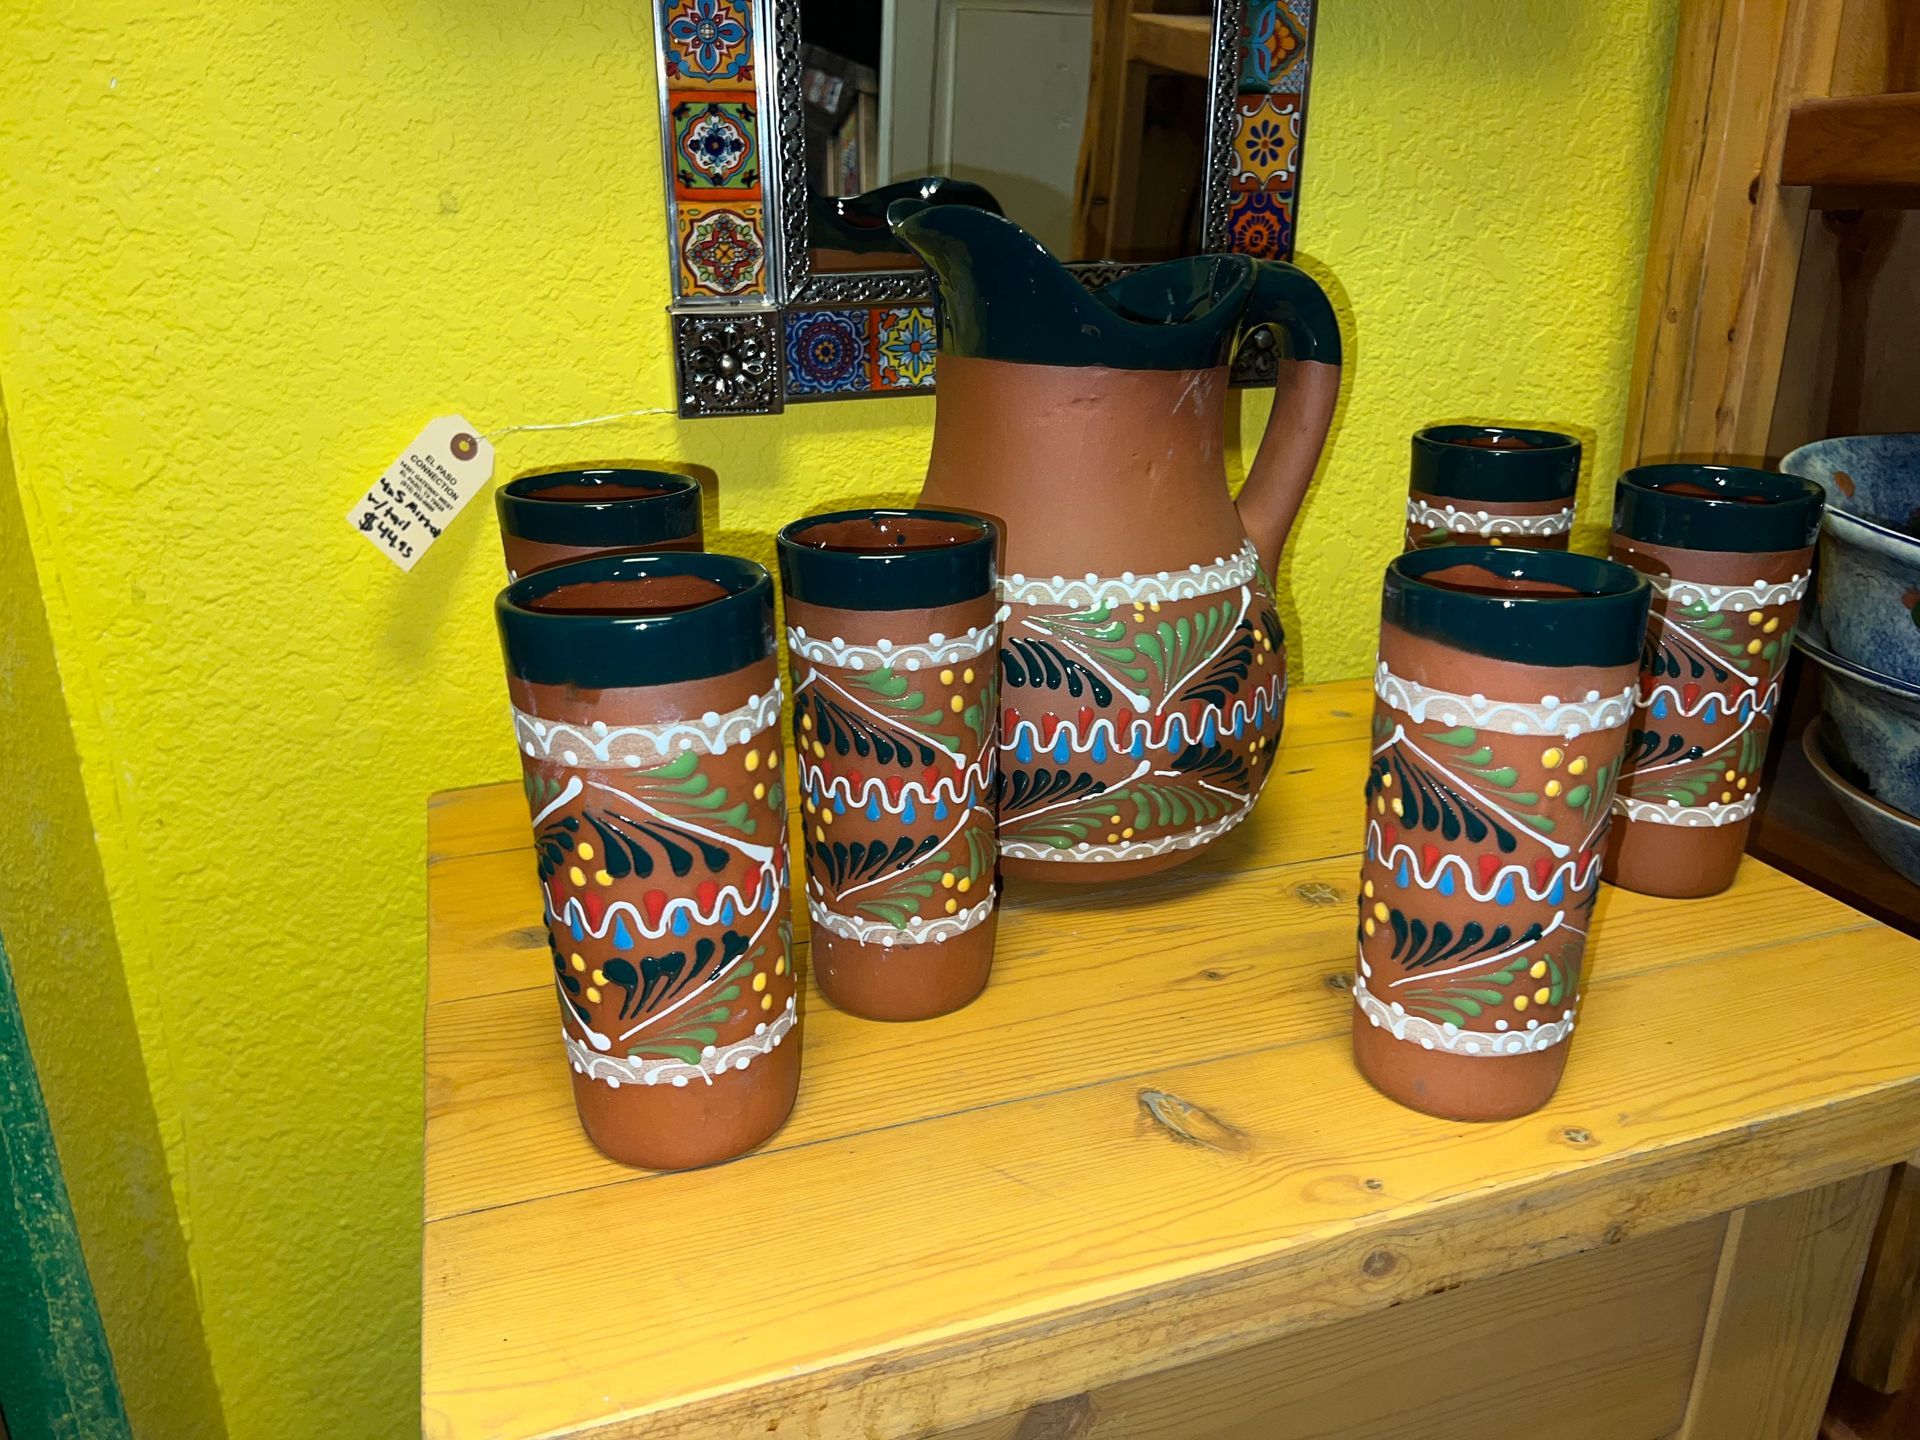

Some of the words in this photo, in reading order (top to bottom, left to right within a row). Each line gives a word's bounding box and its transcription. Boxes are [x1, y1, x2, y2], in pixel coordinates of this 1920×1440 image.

[399, 470, 407, 478] EL
[410, 454, 459, 501] CONNECTION
[425, 454, 435, 467] EL
[436, 464, 458, 486] PASO
[414, 473, 440, 498] GATEWAY
[438, 496, 454, 511] WEST
[358, 512, 414, 558] $44.95
